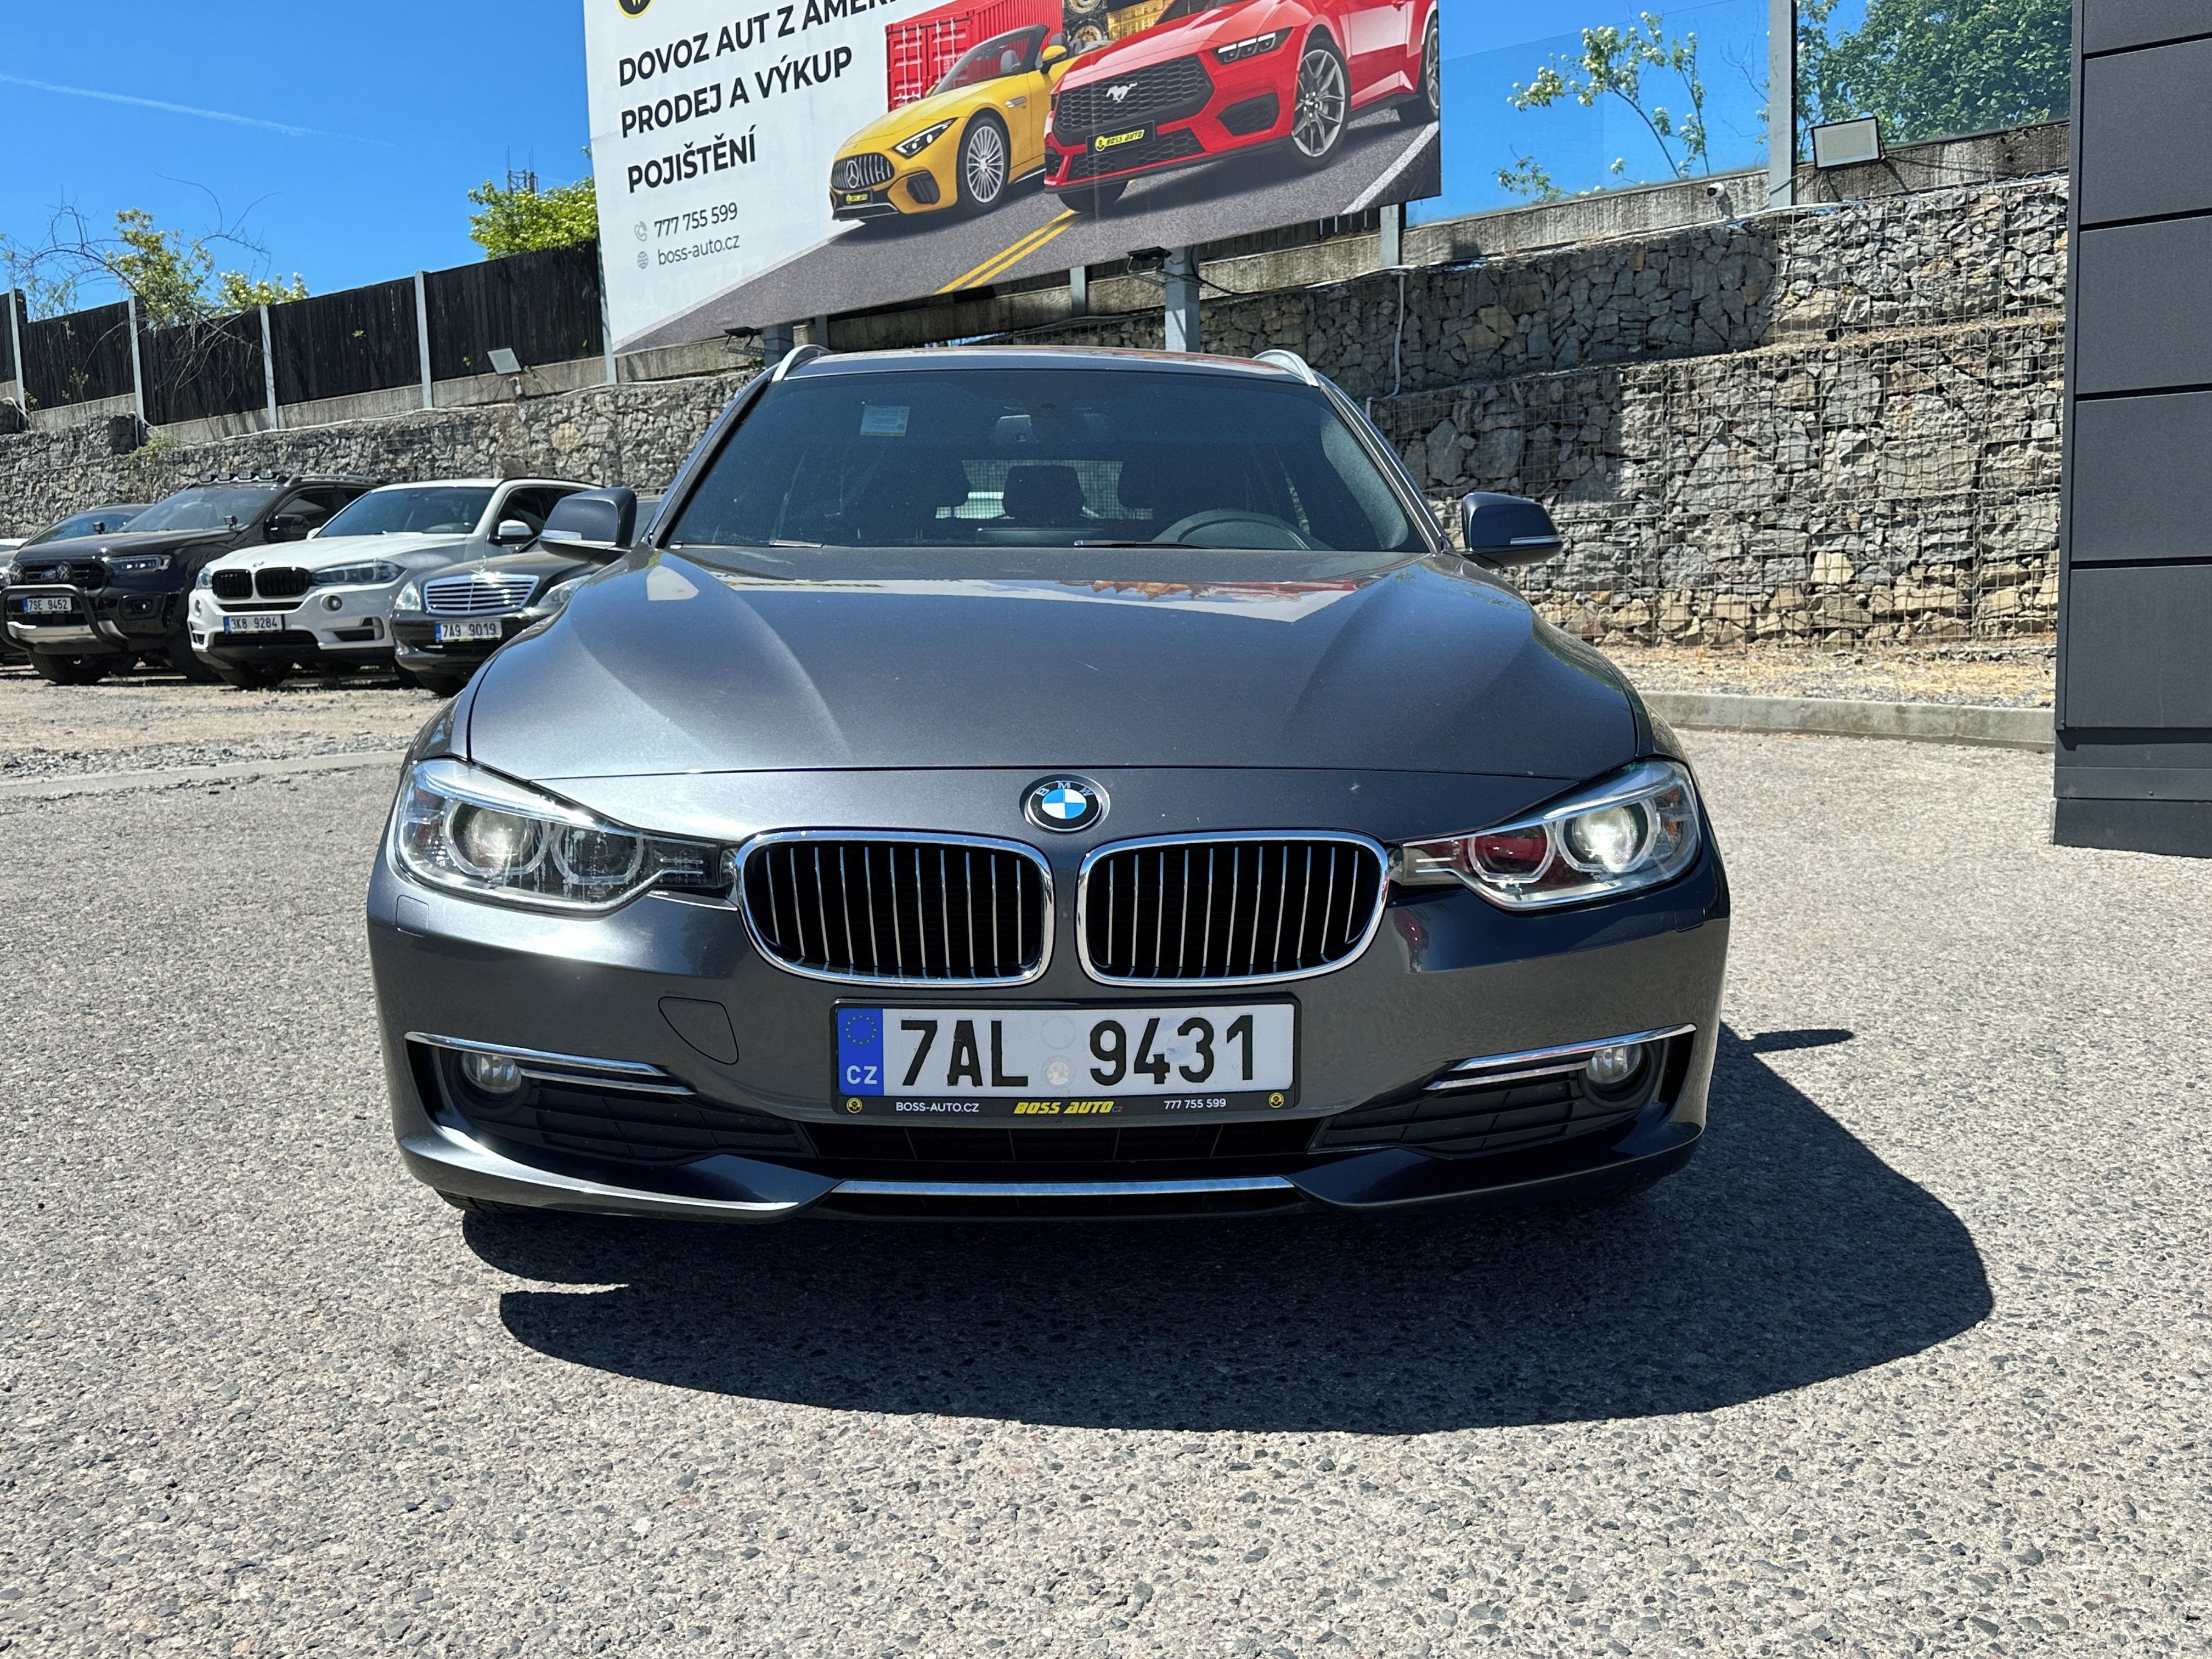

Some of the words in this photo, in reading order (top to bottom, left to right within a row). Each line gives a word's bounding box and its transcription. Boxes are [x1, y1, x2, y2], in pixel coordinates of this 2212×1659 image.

[619, 31, 709, 87] DOVOZ
[715, 12, 770, 57] AUT
[777, 5, 795, 38] Z
[621, 83, 722, 138] PRODEJ
[729, 77, 750, 109] A
[754, 46, 852, 99] VÝKUP
[628, 125, 757, 194] POJIŠTĚNÍ
[654, 216, 679, 238] 777
[682, 209, 708, 231] 755
[710, 202, 738, 224] 599
[657, 235, 740, 266] boss-auto.cz
[48, 599, 68, 611] 9452
[253, 617, 278, 629] 9284
[443, 624, 461, 637] 7A9
[469, 623, 496, 636] 9019
[1035, 781, 1094, 797] BMW
[901, 1019, 1029, 1087] 7AL
[1090, 1014, 1253, 1086] 9431
[846, 1065, 878, 1085] CZ
[895, 1102, 980, 1113] BOSS-AUTO.CZ
[1013, 1101, 1062, 1114] BOSS
[1063, 1101, 1115, 1114] AUTO
[1164, 1100, 1182, 1110] 777
[1184, 1099, 1204, 1109] 755
[1206, 1098, 1227, 1108] 599
